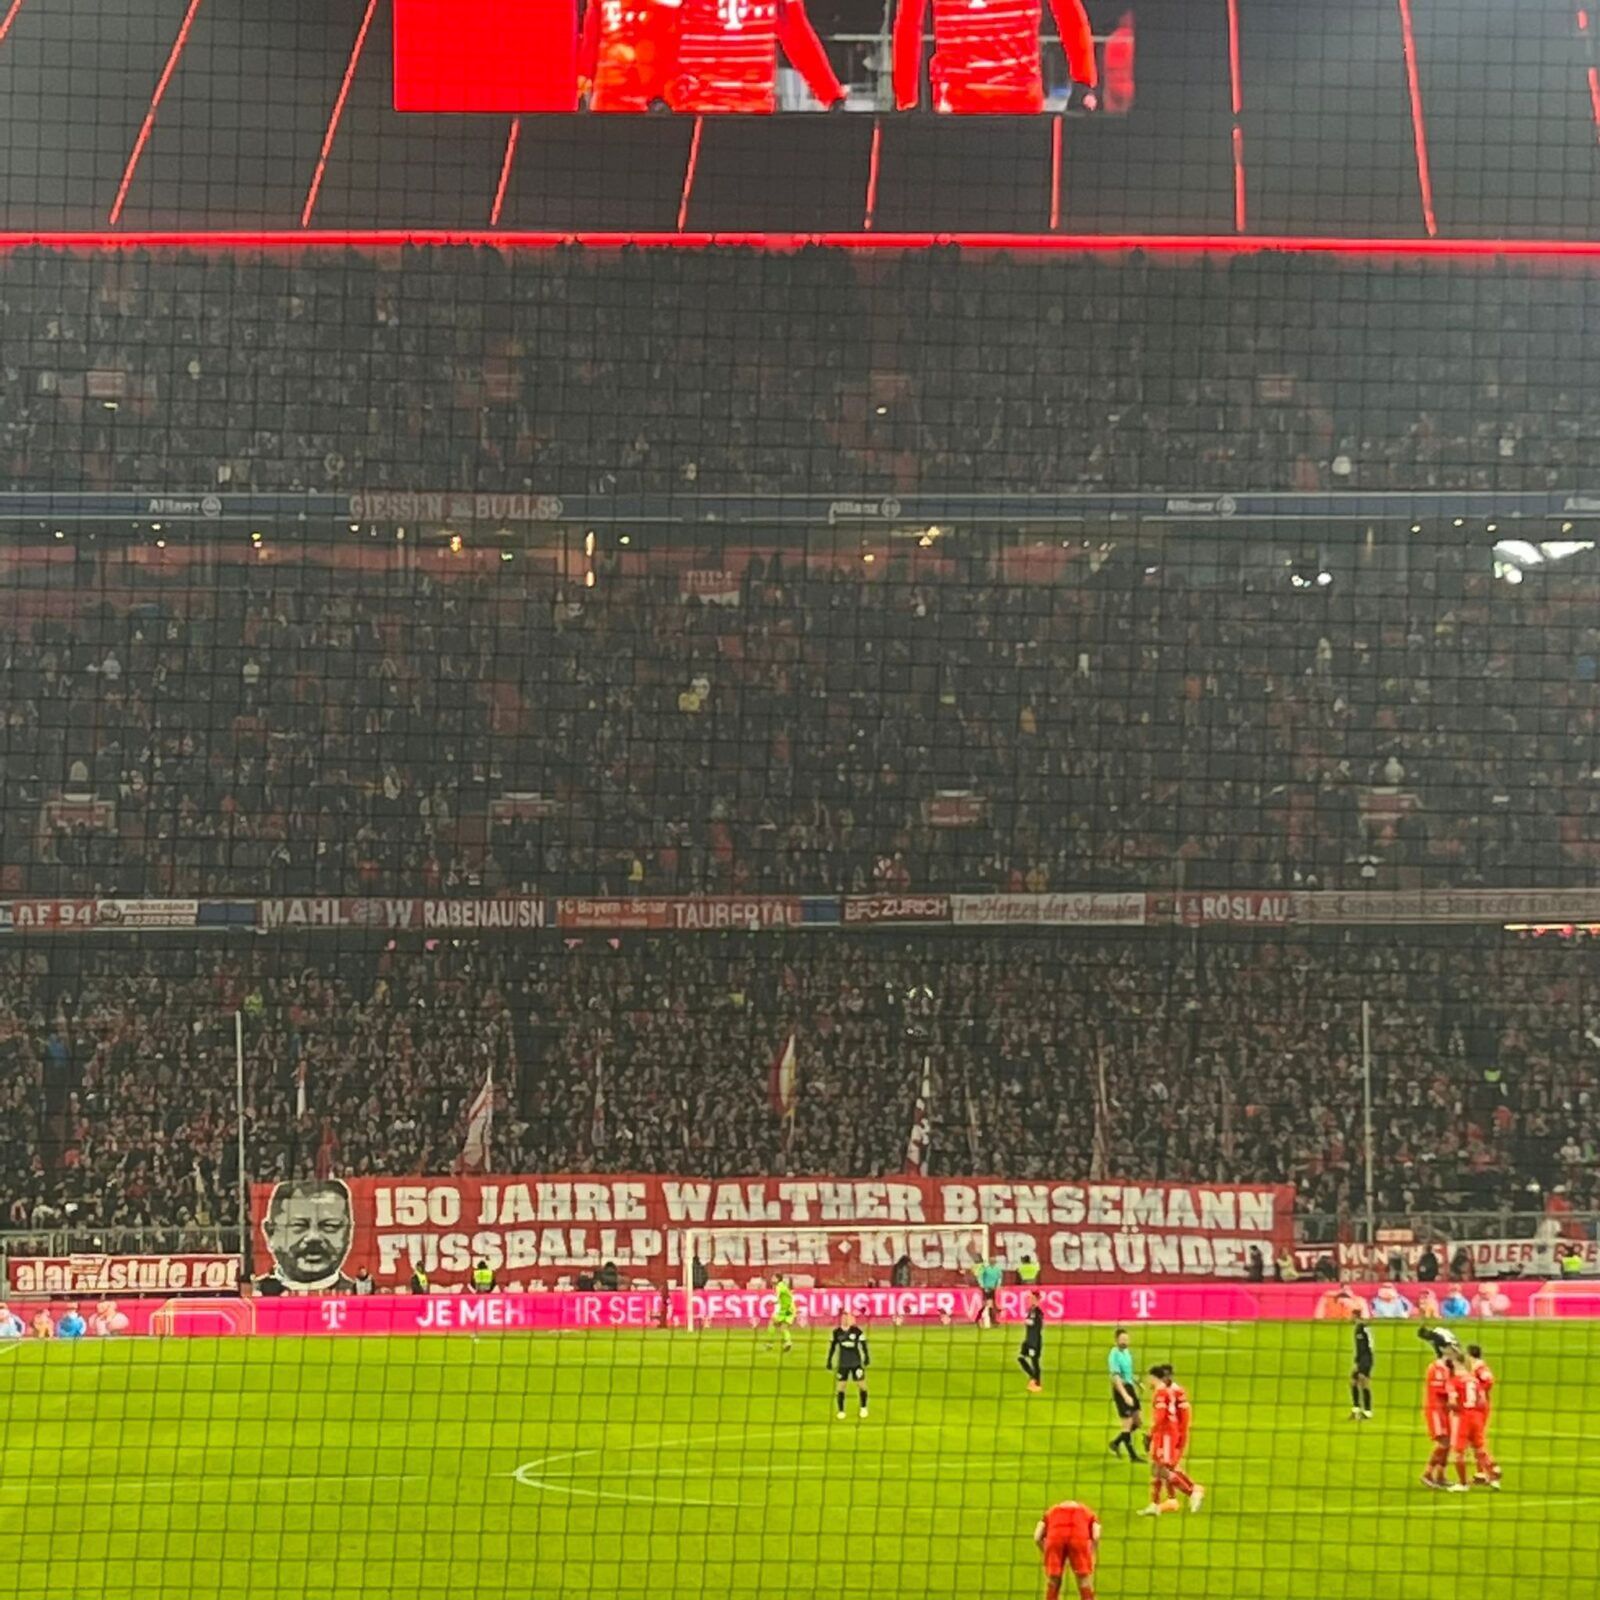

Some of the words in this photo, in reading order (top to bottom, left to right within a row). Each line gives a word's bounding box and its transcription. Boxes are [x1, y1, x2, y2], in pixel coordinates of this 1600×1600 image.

[59, 905, 91, 925] 94
[375, 1186, 461, 1227] 150
[477, 1182, 647, 1225] JAHRE
[661, 1182, 926, 1223] WALTHER
[940, 1184, 1276, 1231] BENSEMANN
[192, 1258, 239, 1290] rot
[416, 1300, 452, 1327] JE
